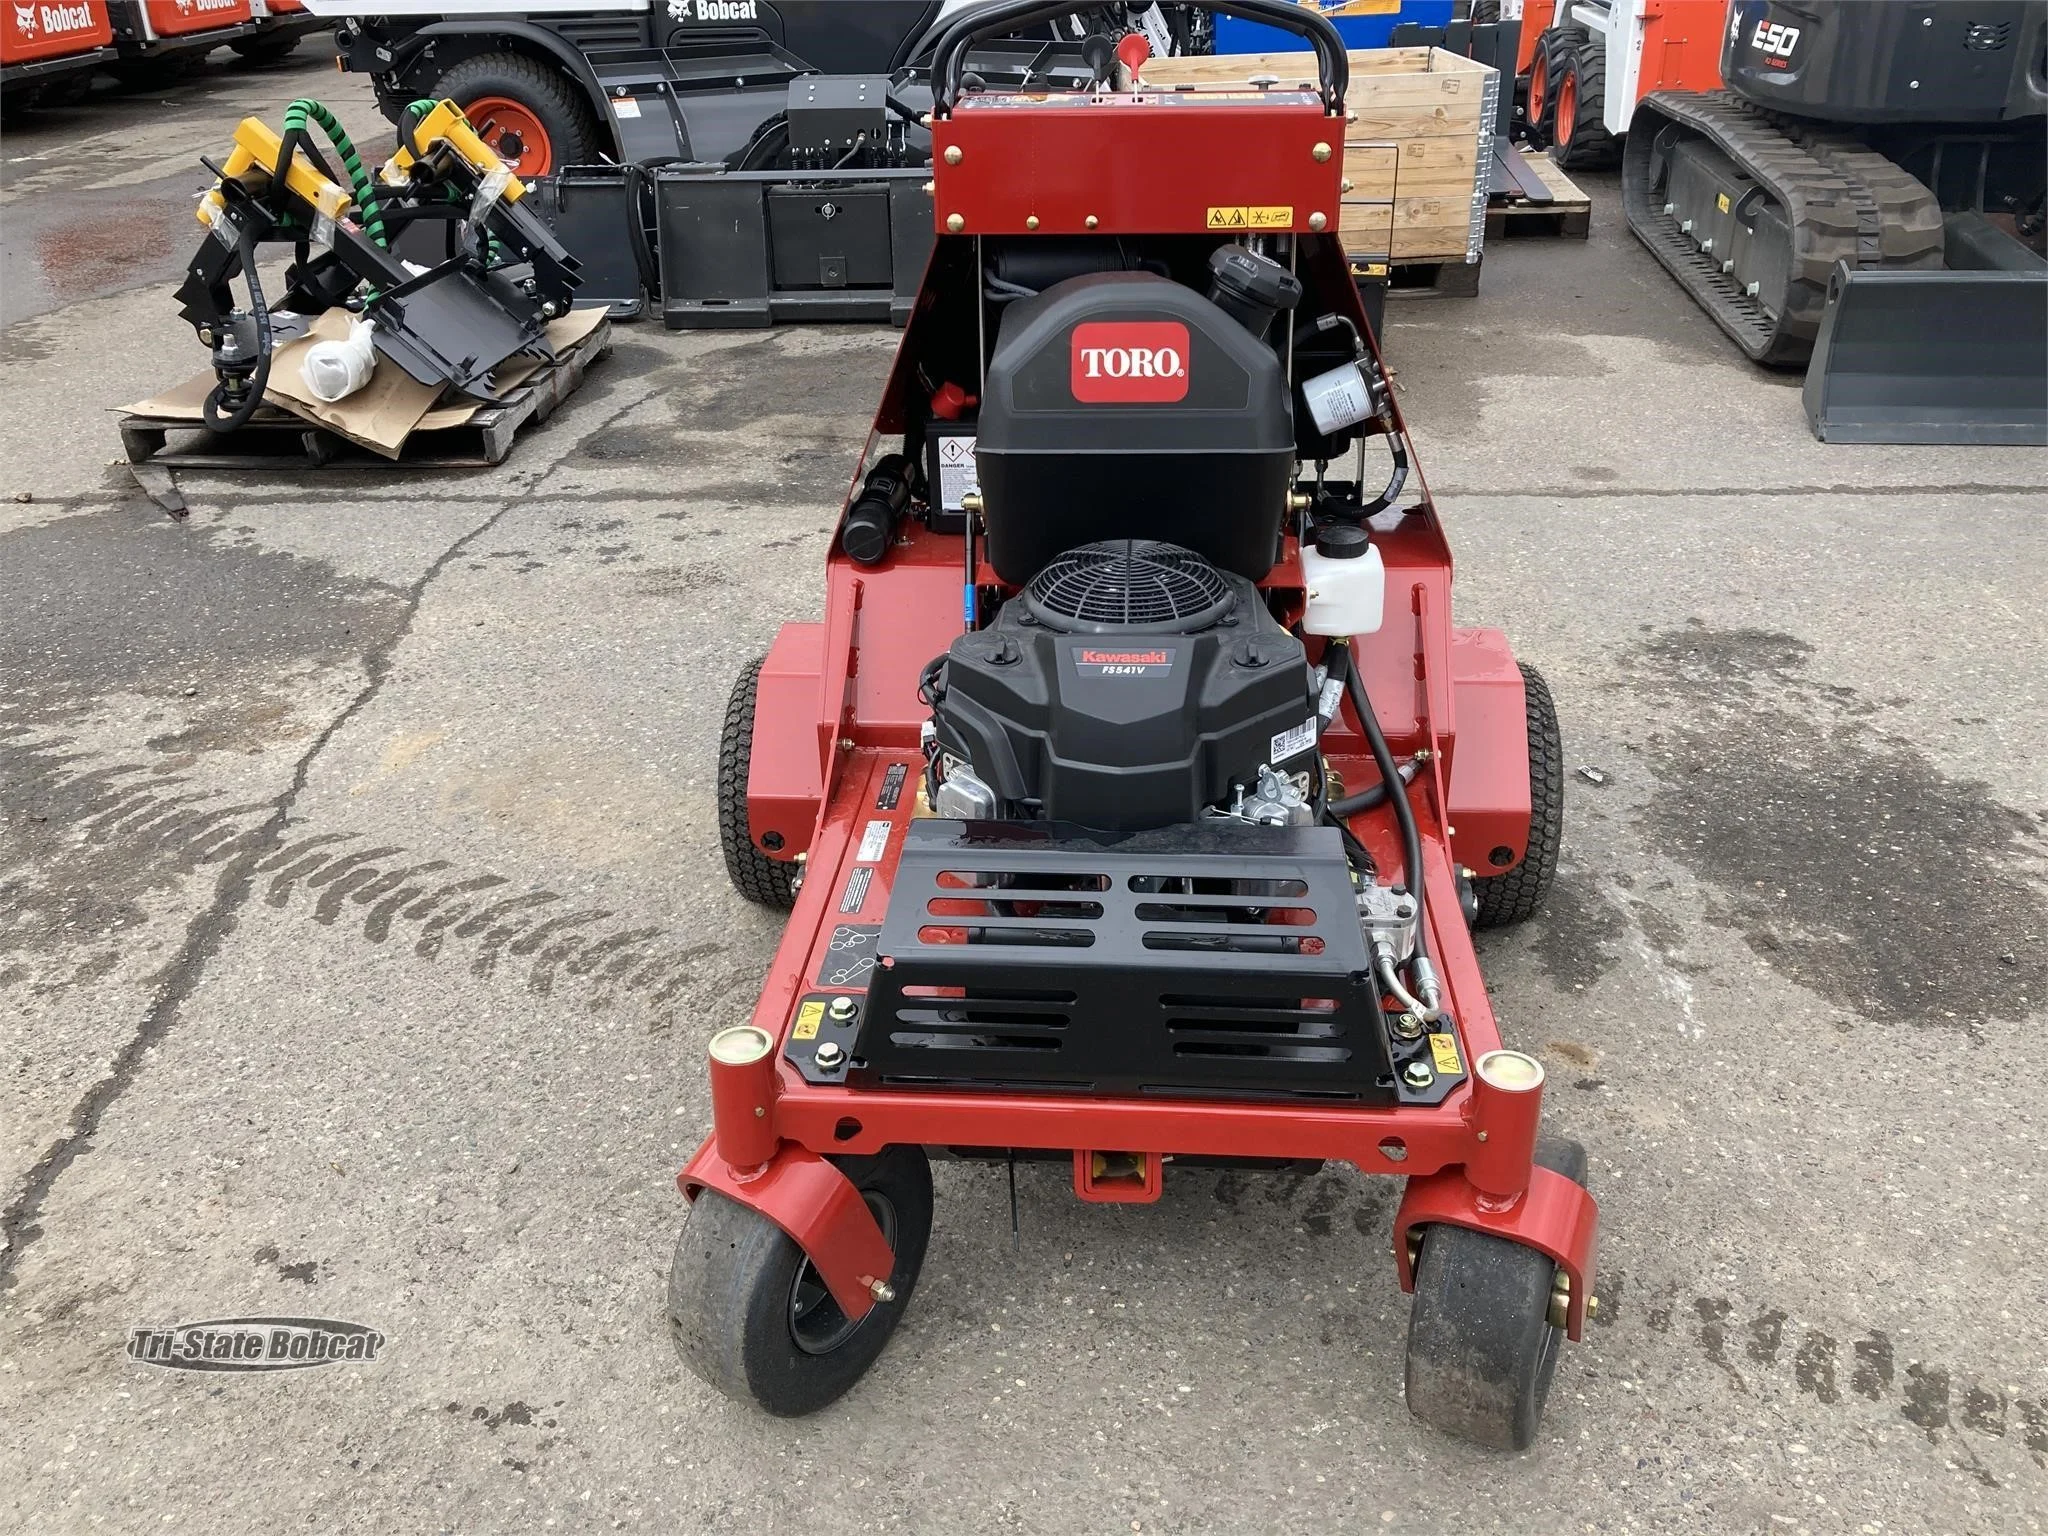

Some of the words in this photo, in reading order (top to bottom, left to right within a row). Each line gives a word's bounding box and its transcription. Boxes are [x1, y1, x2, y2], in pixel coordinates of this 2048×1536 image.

[40, 2, 94, 34] Bobcat
[695, 0, 758, 20] Bobcat
[1751, 19, 1800, 57] E50
[1082, 650, 1167, 663] Kawasaki
[1101, 665, 1145, 674] FS541V
